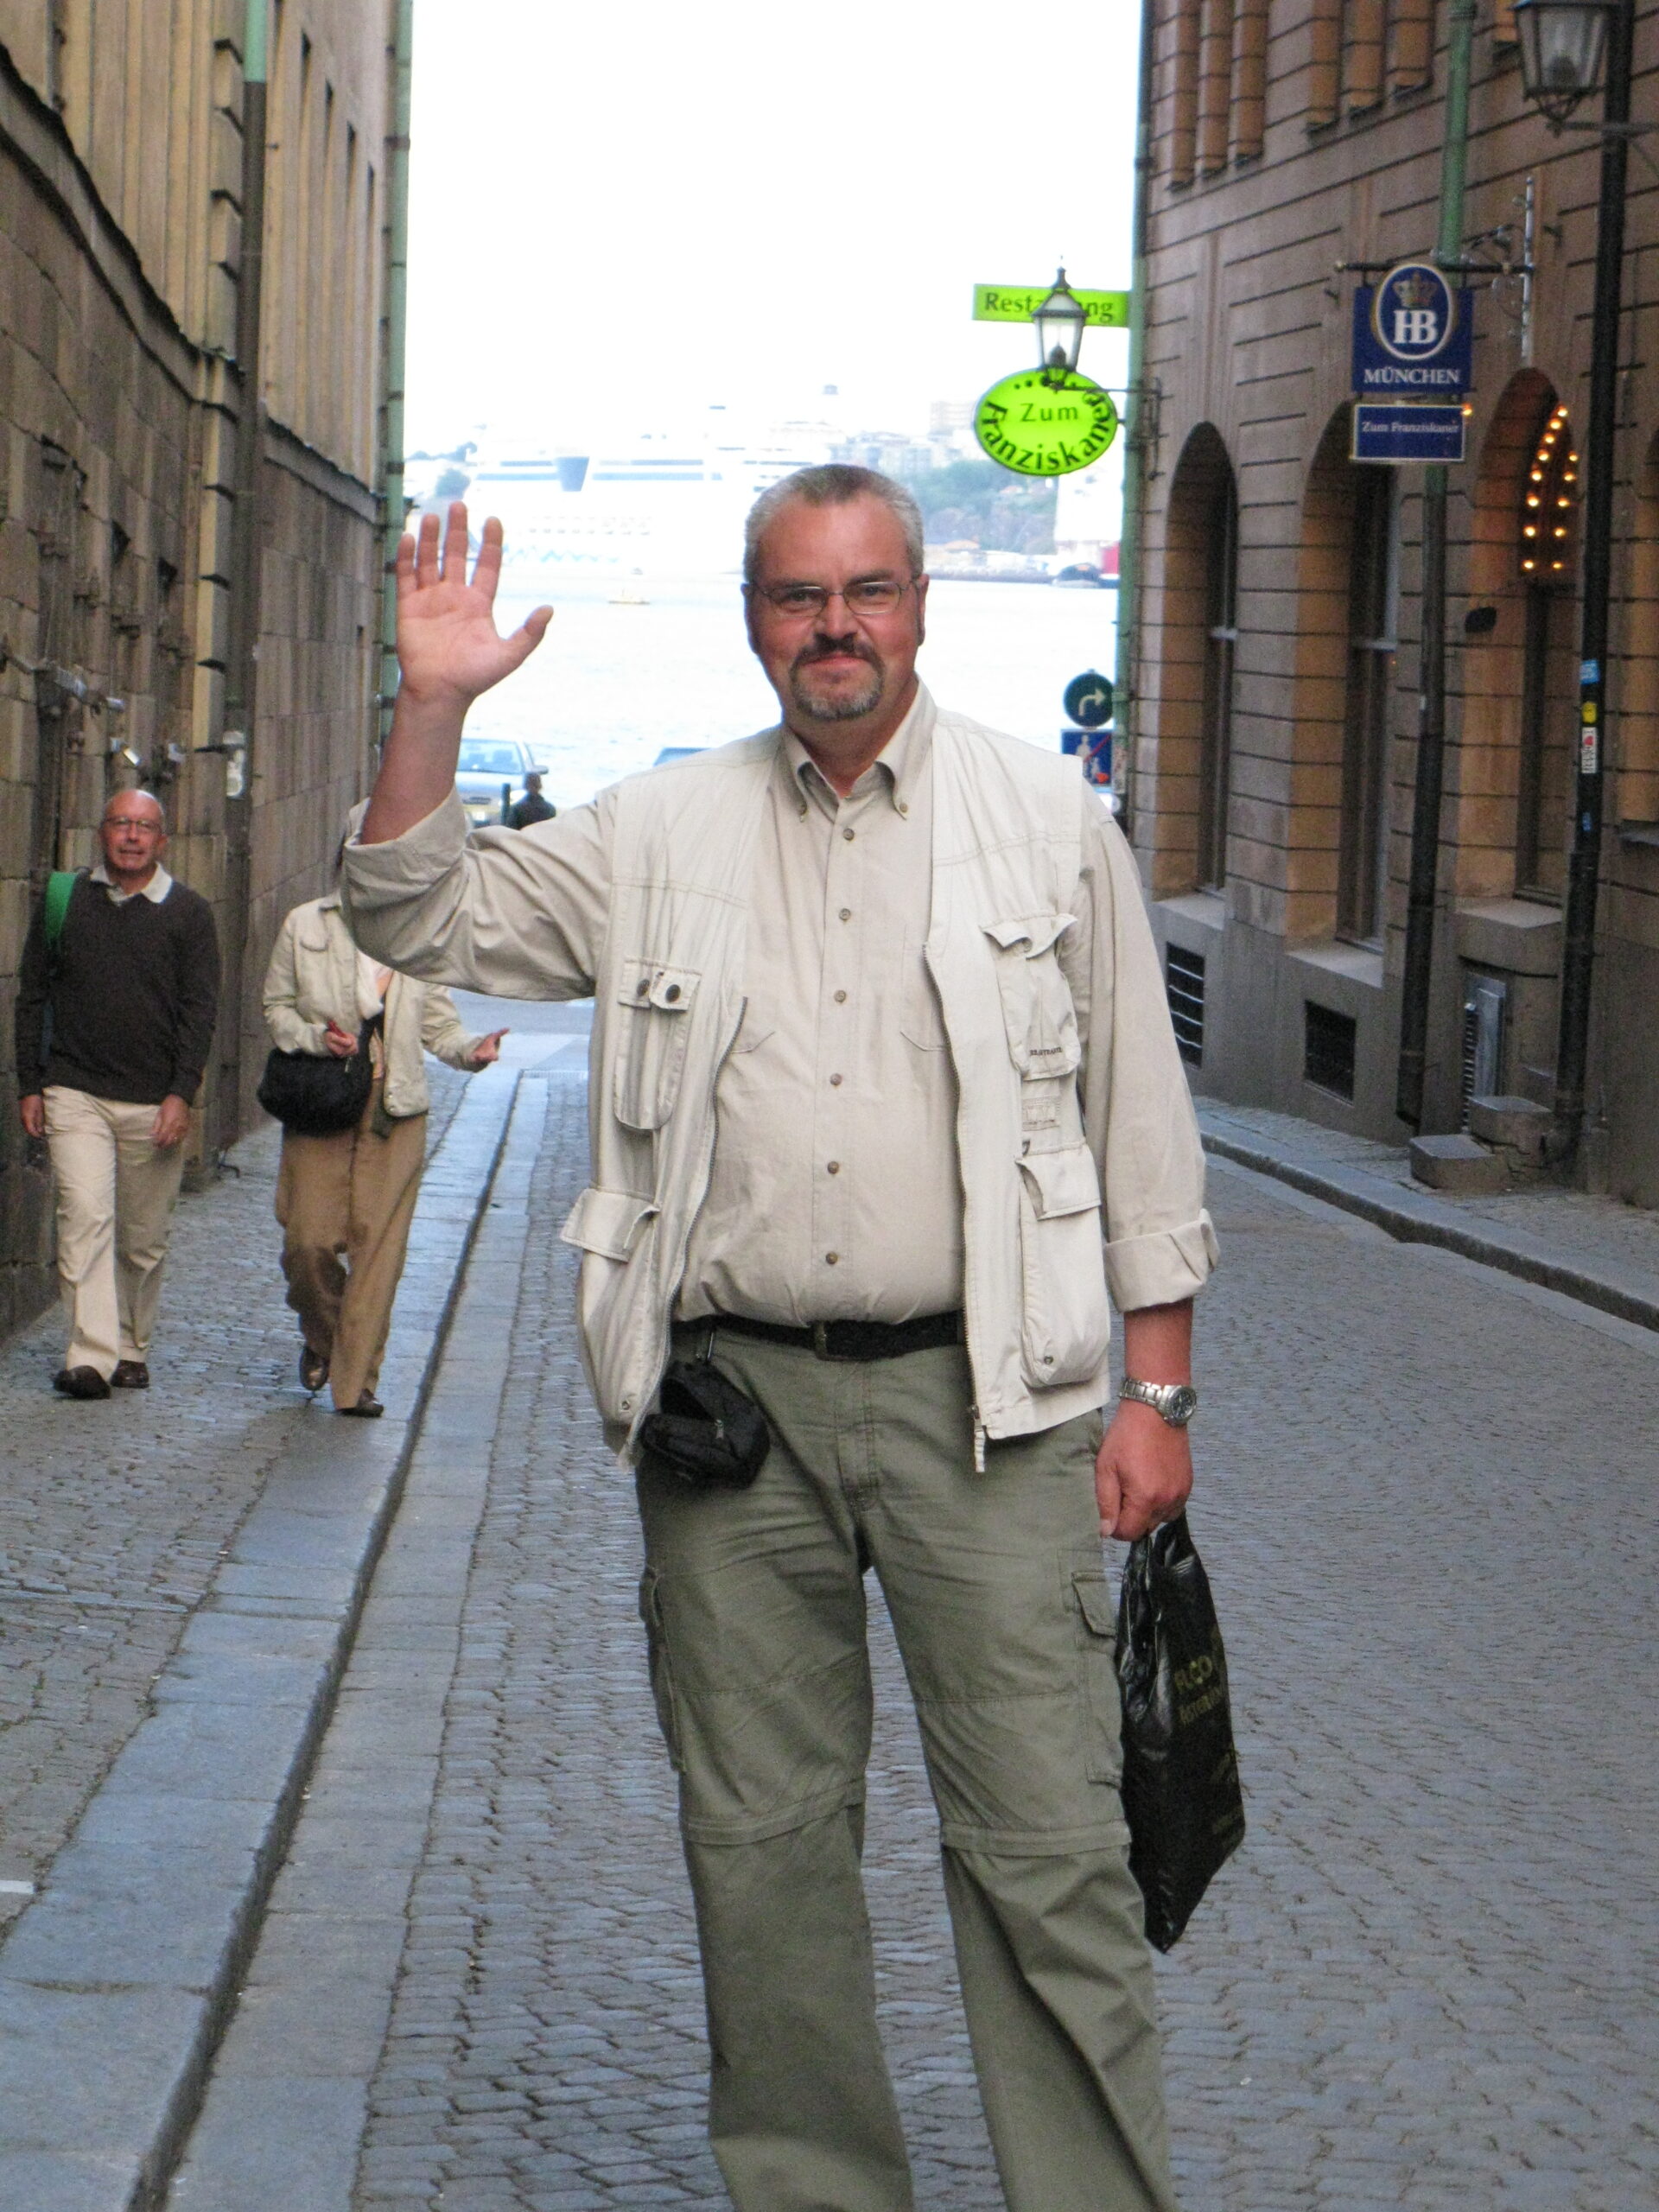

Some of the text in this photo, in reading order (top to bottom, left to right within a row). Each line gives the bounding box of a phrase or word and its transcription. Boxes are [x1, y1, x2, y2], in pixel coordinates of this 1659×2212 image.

[984, 292, 1113, 323] Restng
[1394, 310, 1437, 344] HB
[1364, 367, 1460, 384] MÜNCHEN
[1020, 403, 1078, 422] Zum
[982, 391, 1111, 470] Franziskaner
[1362, 421, 1459, 433] Zum Franziskaner
